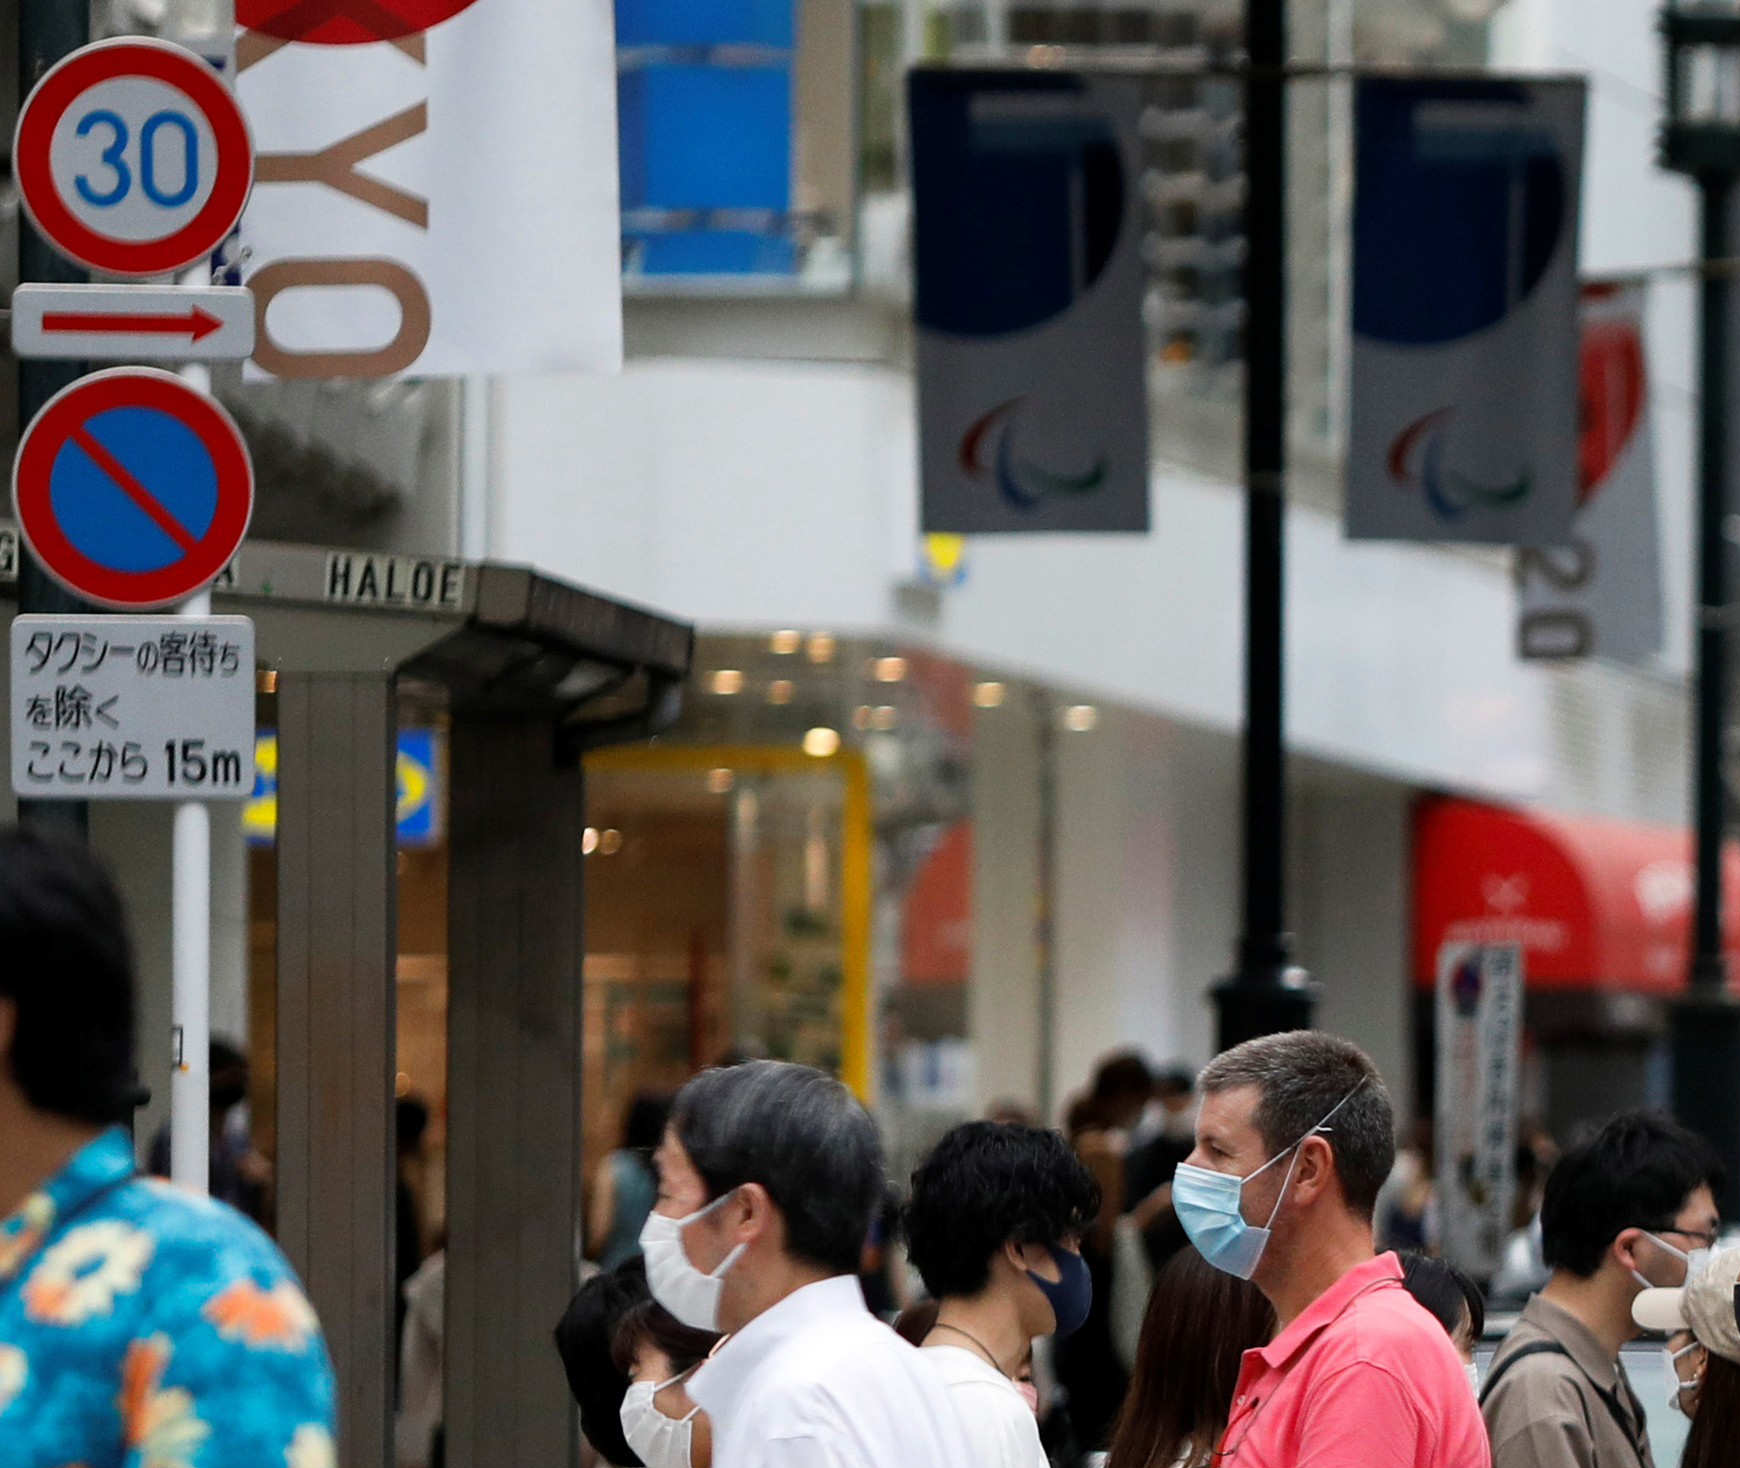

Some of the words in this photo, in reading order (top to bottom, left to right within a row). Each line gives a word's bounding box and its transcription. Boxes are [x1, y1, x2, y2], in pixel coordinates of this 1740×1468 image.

[73, 109, 200, 208] 30
[25, 630, 241, 678] タクシーの客待ち
[25, 684, 120, 730] を除く
[27, 738, 149, 785] ここから
[165, 738, 242, 786] 15m
